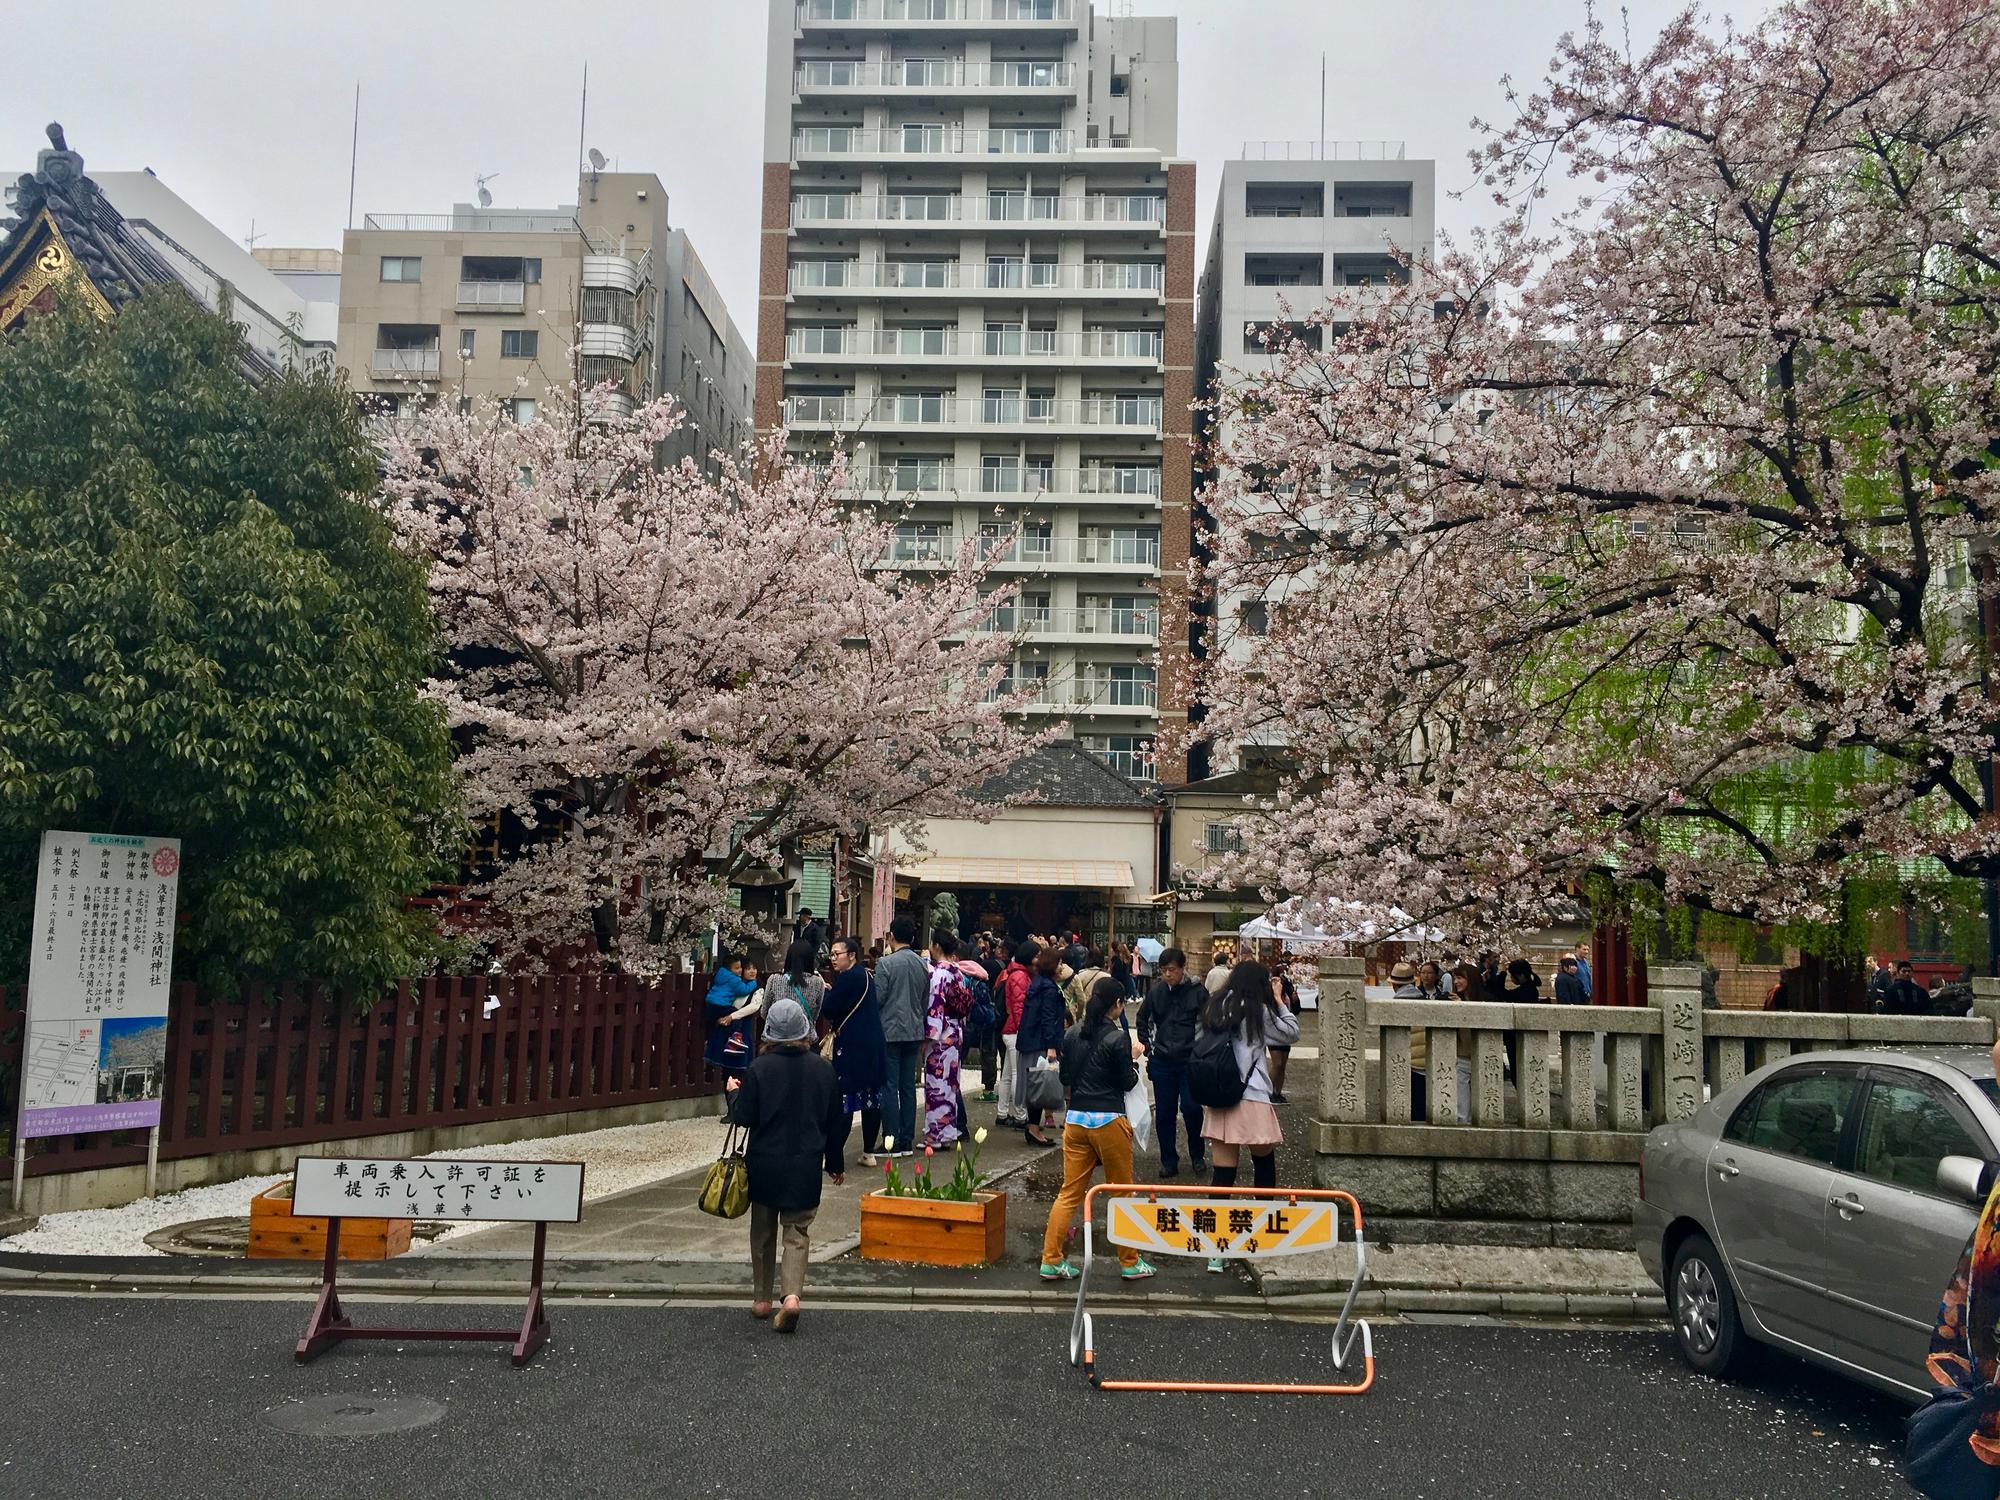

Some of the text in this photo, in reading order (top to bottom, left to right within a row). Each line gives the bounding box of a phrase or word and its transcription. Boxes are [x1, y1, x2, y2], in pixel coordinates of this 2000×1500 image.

[100, 848, 111, 879] 御由緒
[126, 849, 137, 880] 御神徳
[140, 851, 150, 880] 御祭神
[67, 847, 81, 917] 例大祭 七月一日
[46, 846, 63, 961] 植木市 五月・六月最終土日
[149, 883, 168, 987] 浅草富士 浅間神社
[333, 1161, 546, 1182] 車両乗入許可証を
[344, 1181, 532, 1199] 提示して下さい
[406, 1202, 473, 1217] 浅草寺
[1155, 1208, 1289, 1234] 駐輪禁止
[1186, 1237, 1260, 1254] 浅草寺
